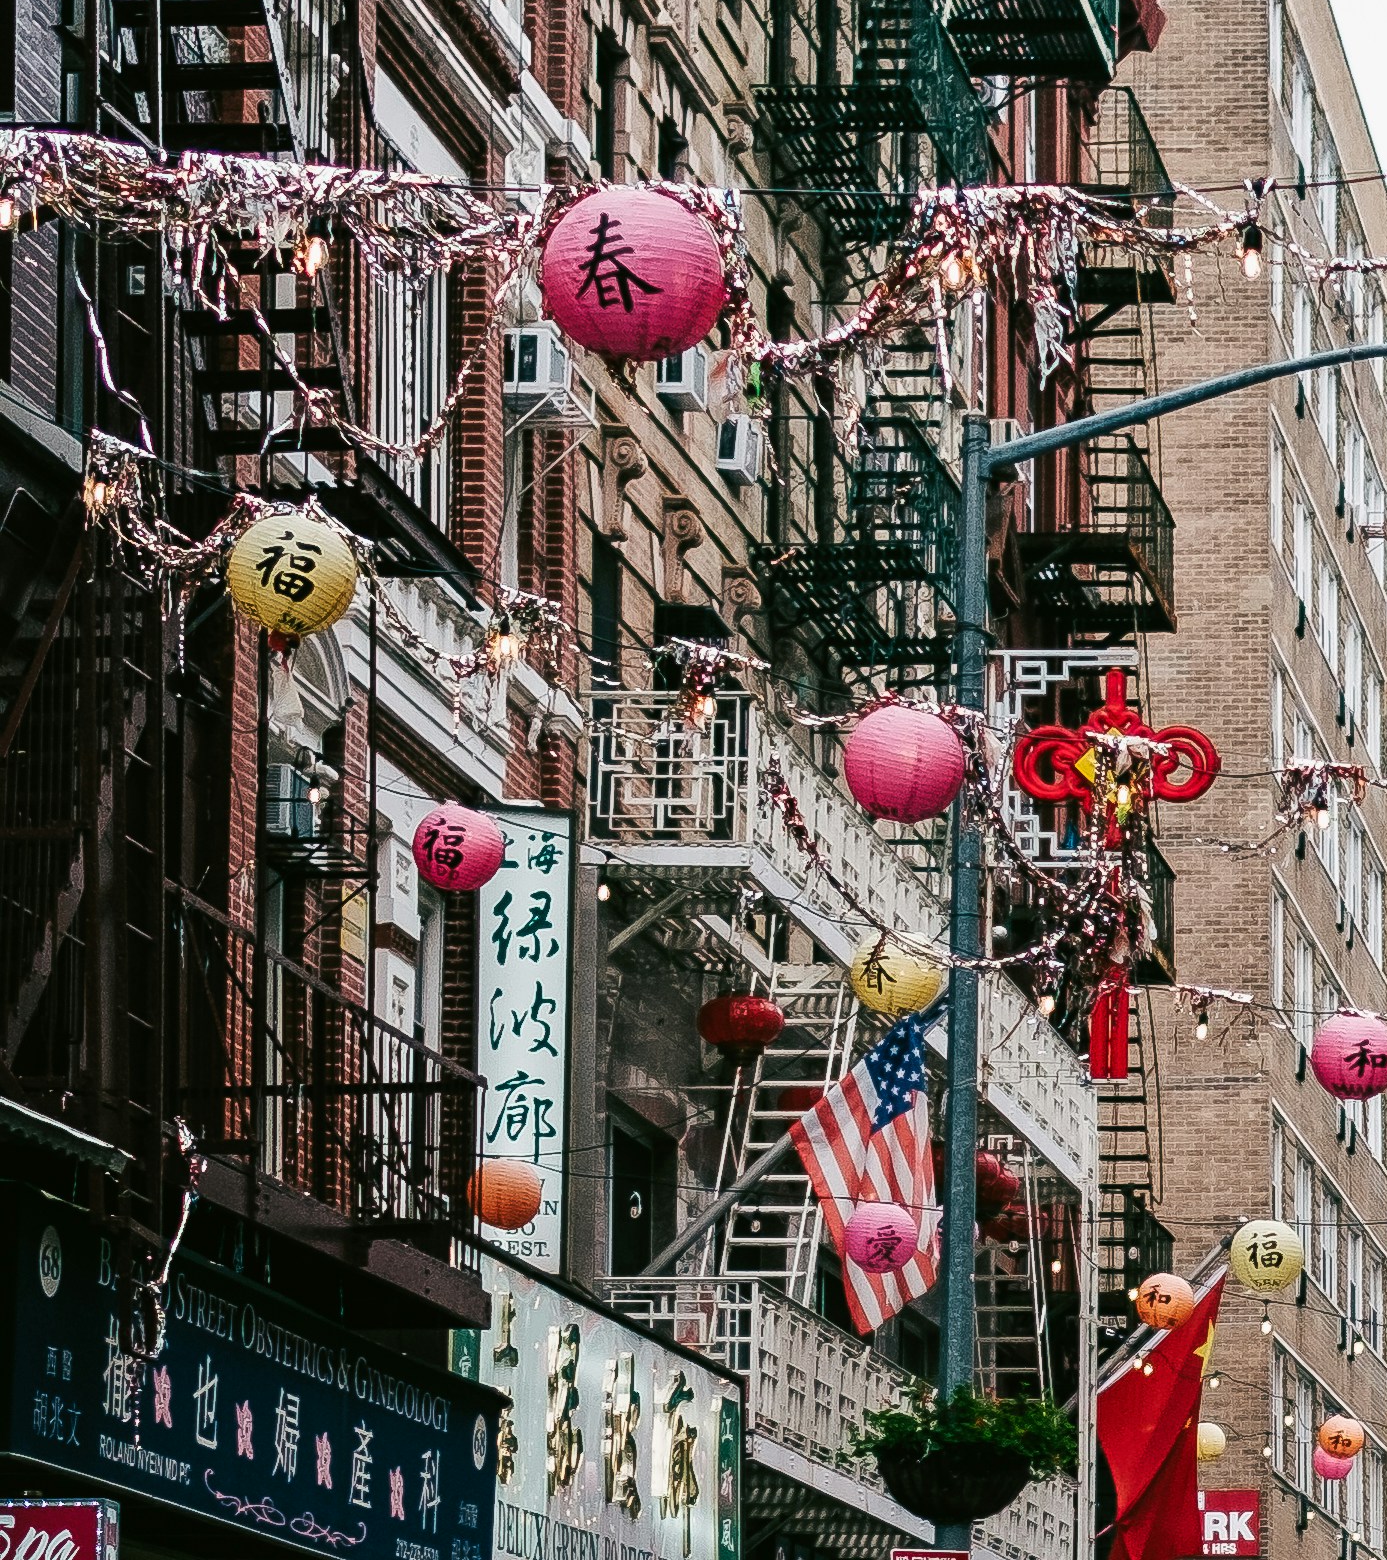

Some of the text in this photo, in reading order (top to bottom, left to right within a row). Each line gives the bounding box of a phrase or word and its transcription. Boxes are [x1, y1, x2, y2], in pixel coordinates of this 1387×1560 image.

[576, 212, 664, 314] 春
[256, 530, 322, 603] 福
[424, 818, 466, 870] 福
[859, 935, 898, 995] 春
[40, 1244, 61, 1282] 68
[866, 1224, 903, 1263] 愛
[1246, 1232, 1284, 1269] 福
[175, 1272, 238, 1342] STREET
[1143, 1284, 1172, 1308] 和
[1328, 1429, 1352, 1450] 和
[1203, 1511, 1256, 1541] RK
